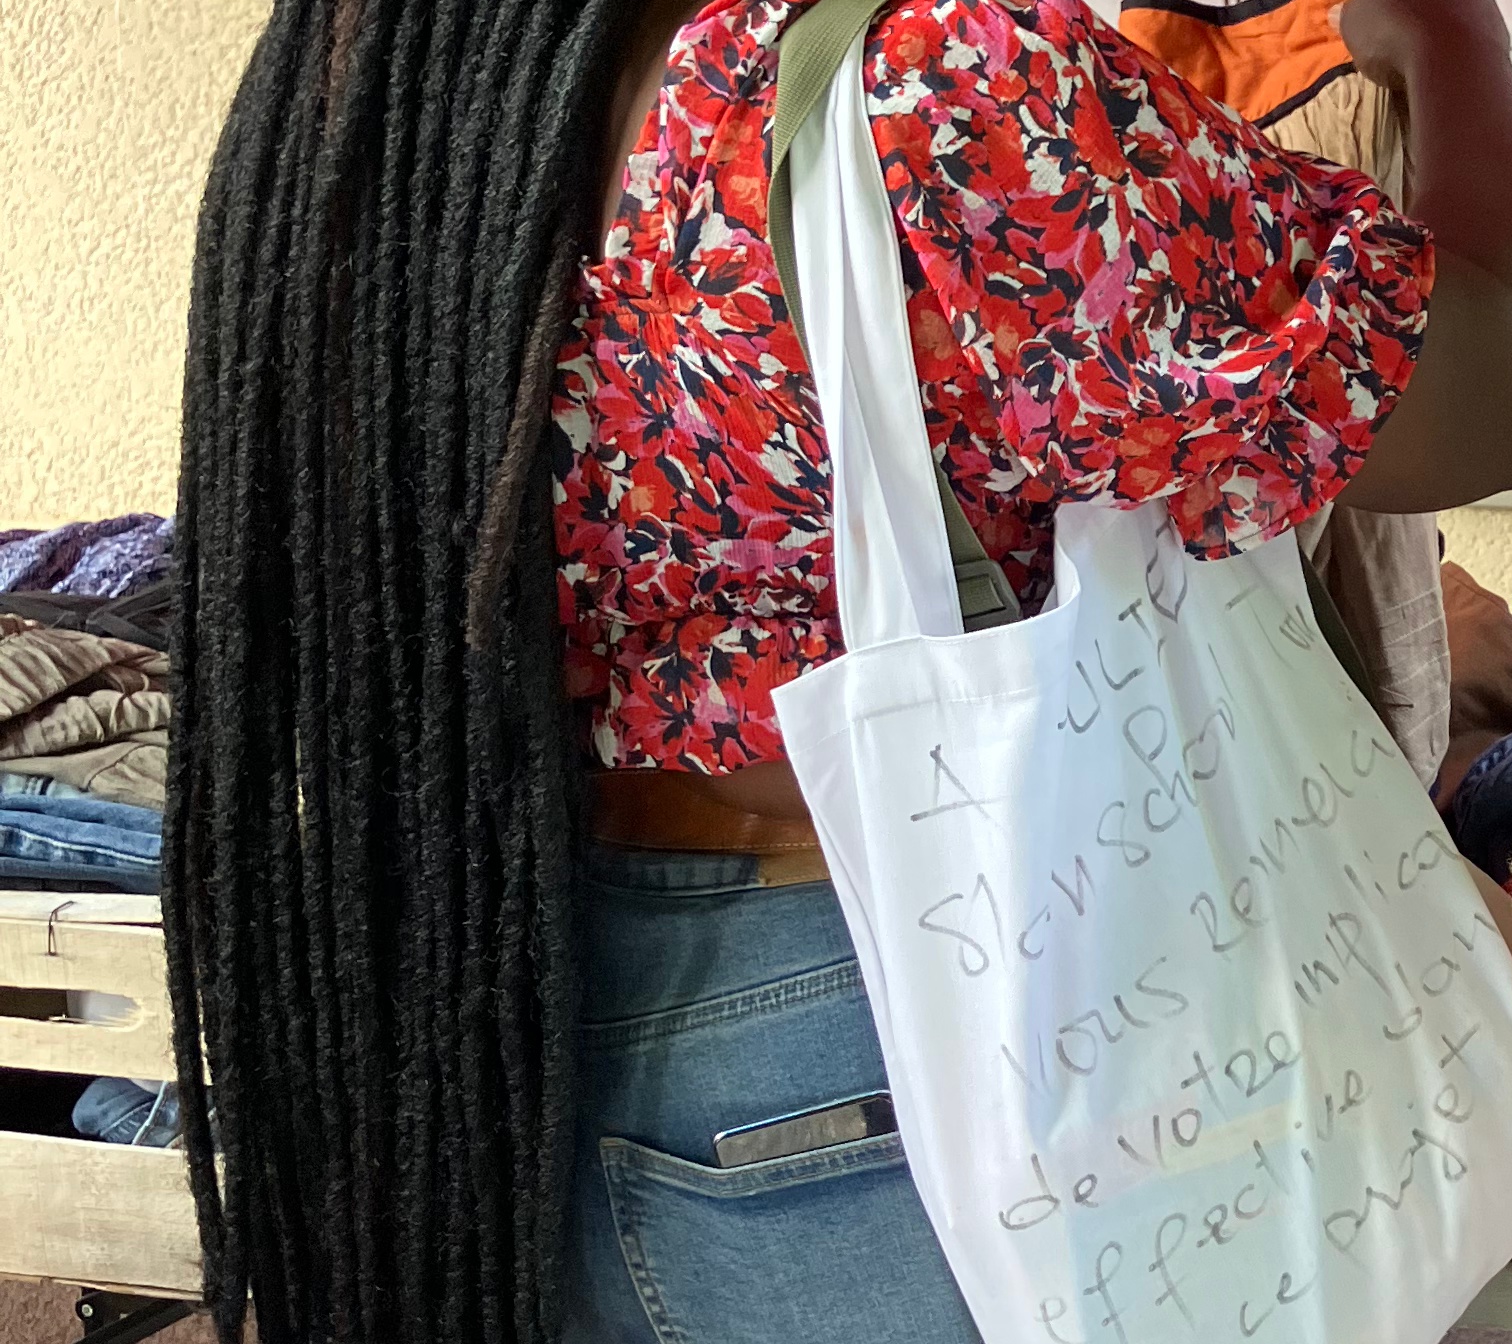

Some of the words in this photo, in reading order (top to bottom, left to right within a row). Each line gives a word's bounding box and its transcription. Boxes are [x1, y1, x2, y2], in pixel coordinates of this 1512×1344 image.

[999, 1153, 1099, 1231] de
[1294, 830, 1459, 1008] implica
[1383, 911, 1498, 1041] dan
[1239, 1272, 1316, 1337] ce
